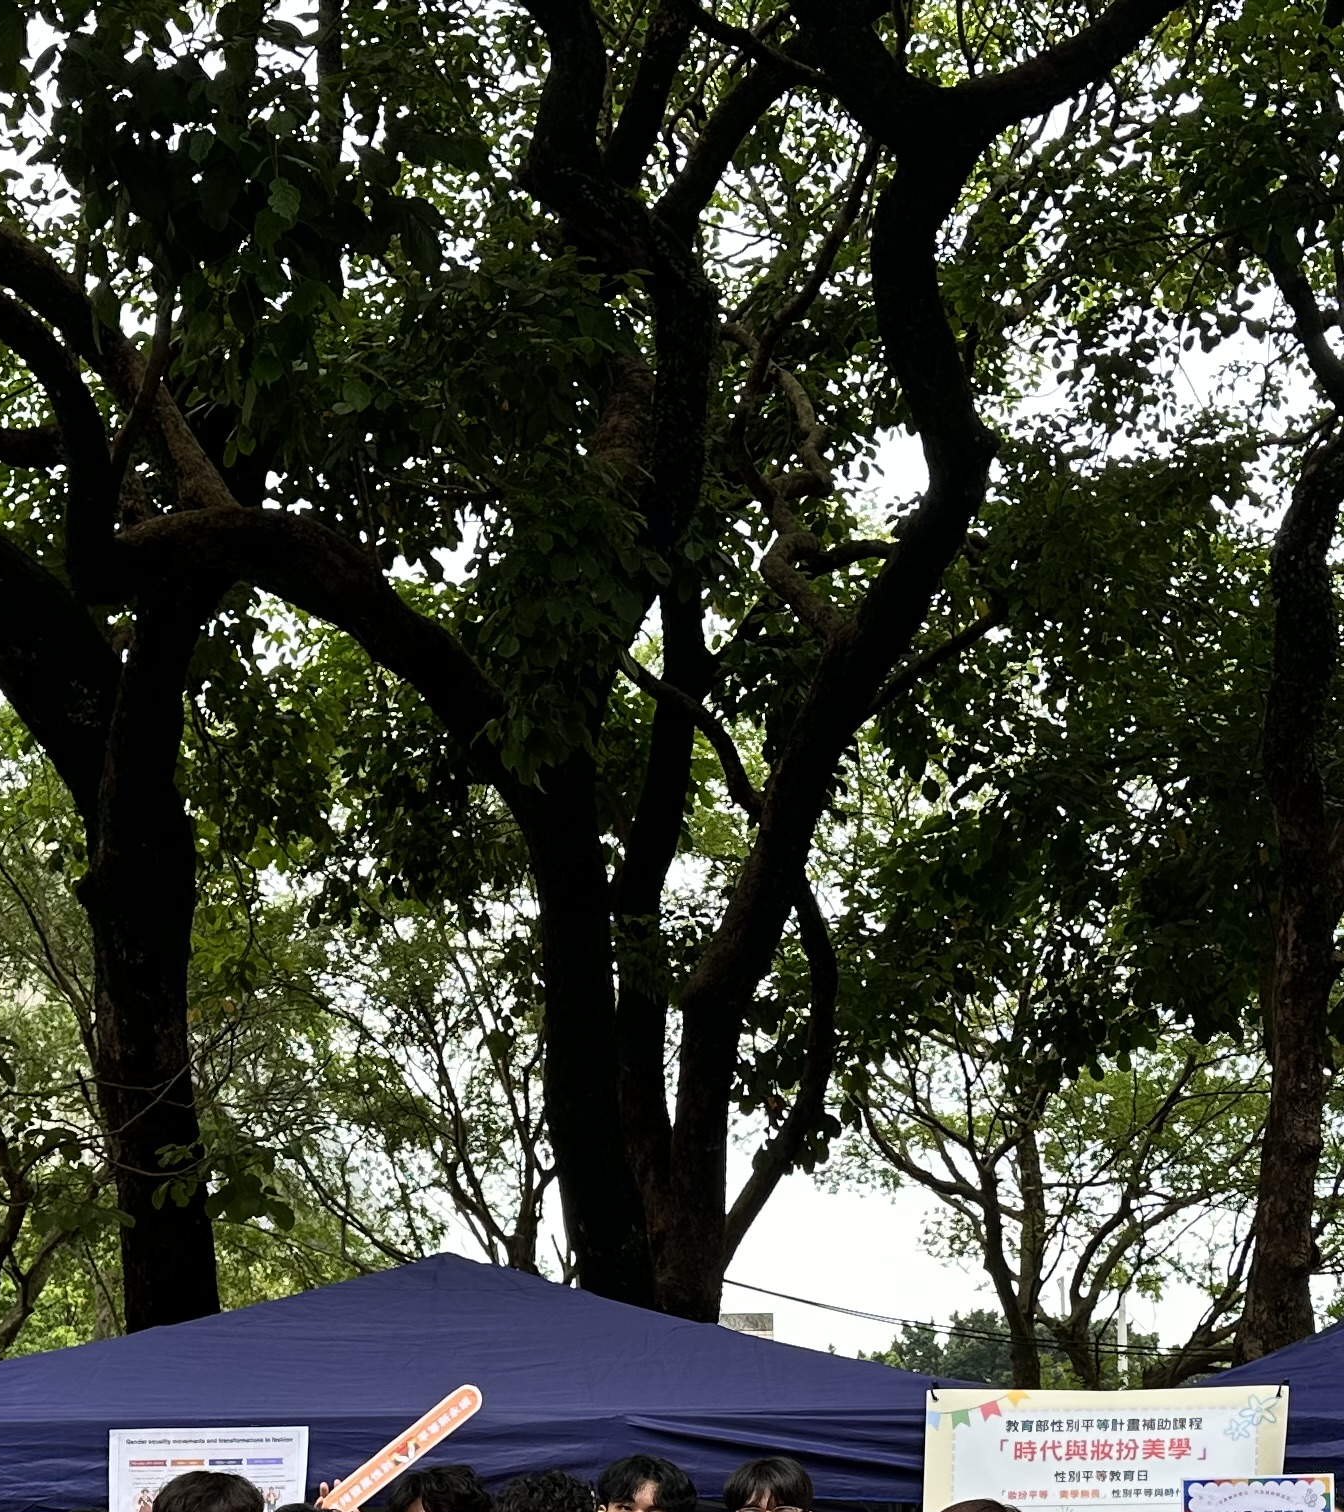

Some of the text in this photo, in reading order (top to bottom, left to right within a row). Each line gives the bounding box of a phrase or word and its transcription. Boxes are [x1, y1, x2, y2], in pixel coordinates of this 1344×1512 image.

[1006, 1417, 1203, 1433] 教育部性別平等計畫補助課程
[999, 1438, 1207, 1462] 「時代與妝扮美學」
[1054, 1469, 1149, 1483] 性別平等教育日
